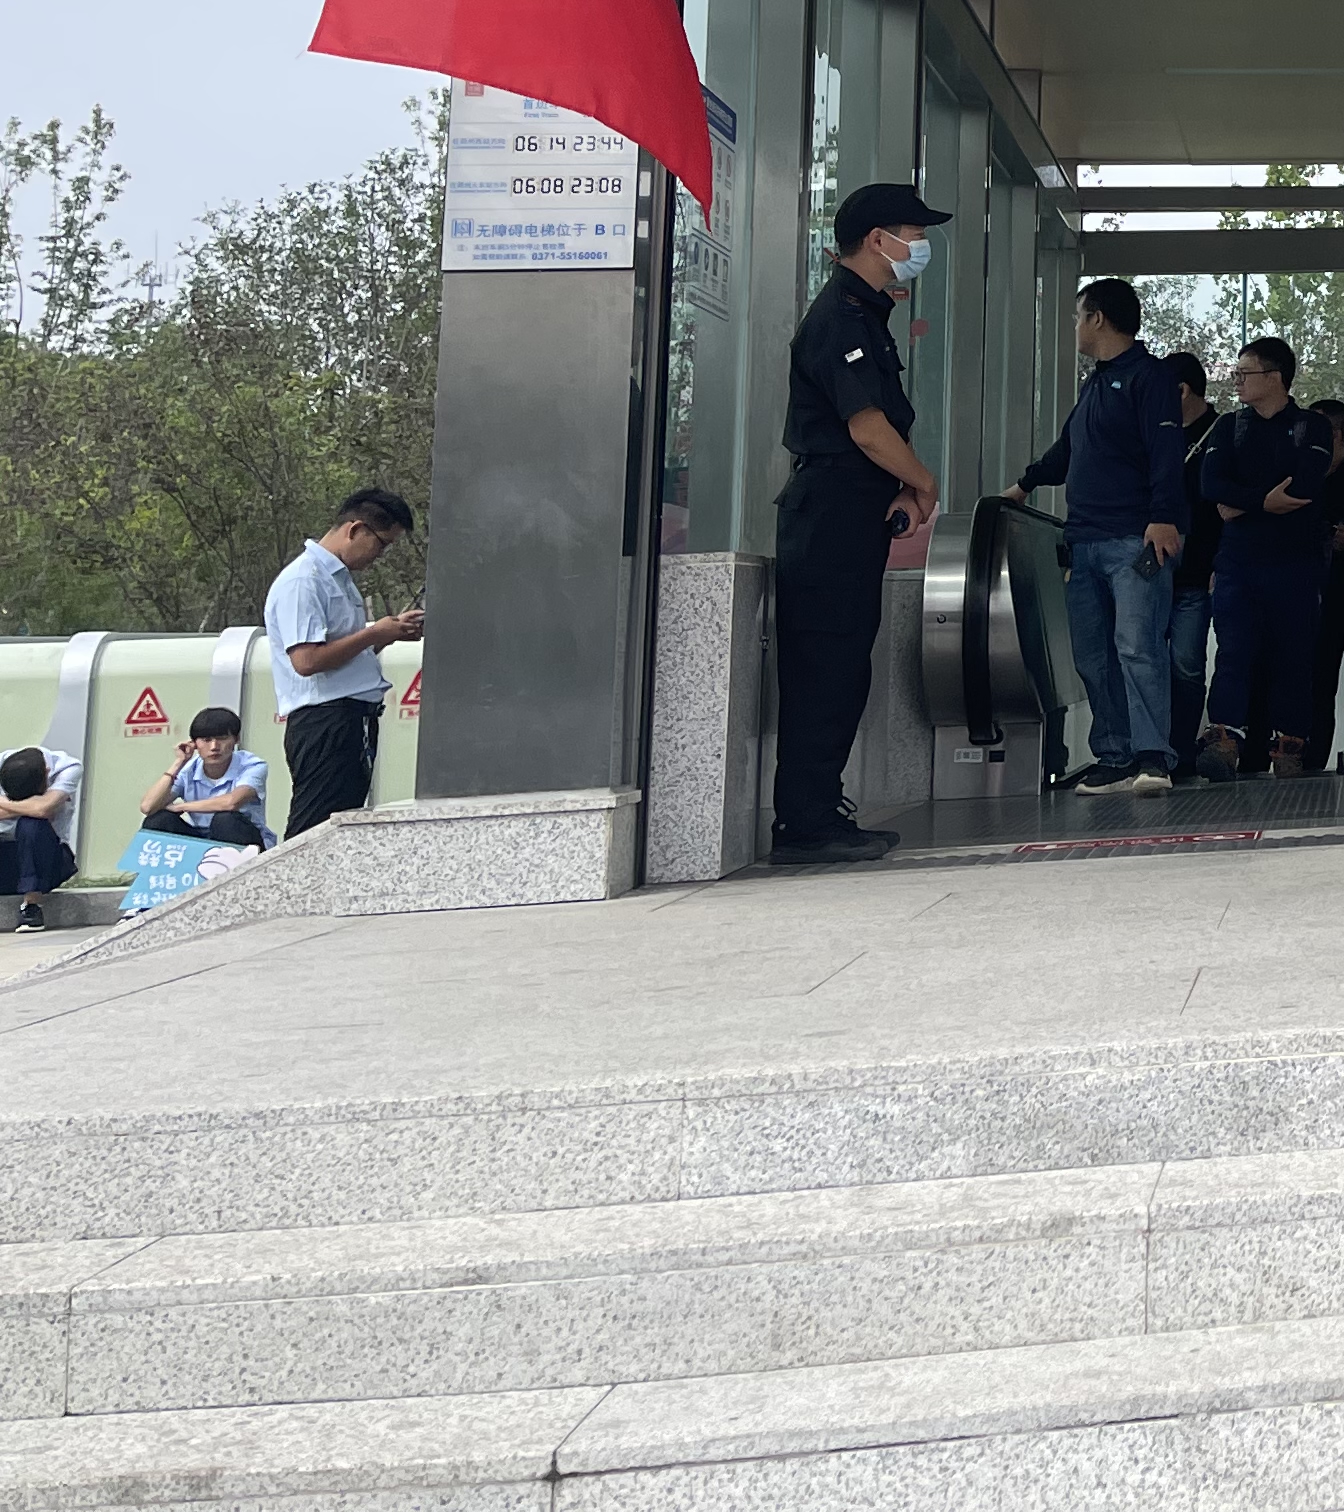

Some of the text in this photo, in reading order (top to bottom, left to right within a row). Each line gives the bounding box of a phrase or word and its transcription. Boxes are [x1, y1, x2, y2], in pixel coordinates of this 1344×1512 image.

[476, 223, 626, 237] 无障碍电梯位于 B 口
